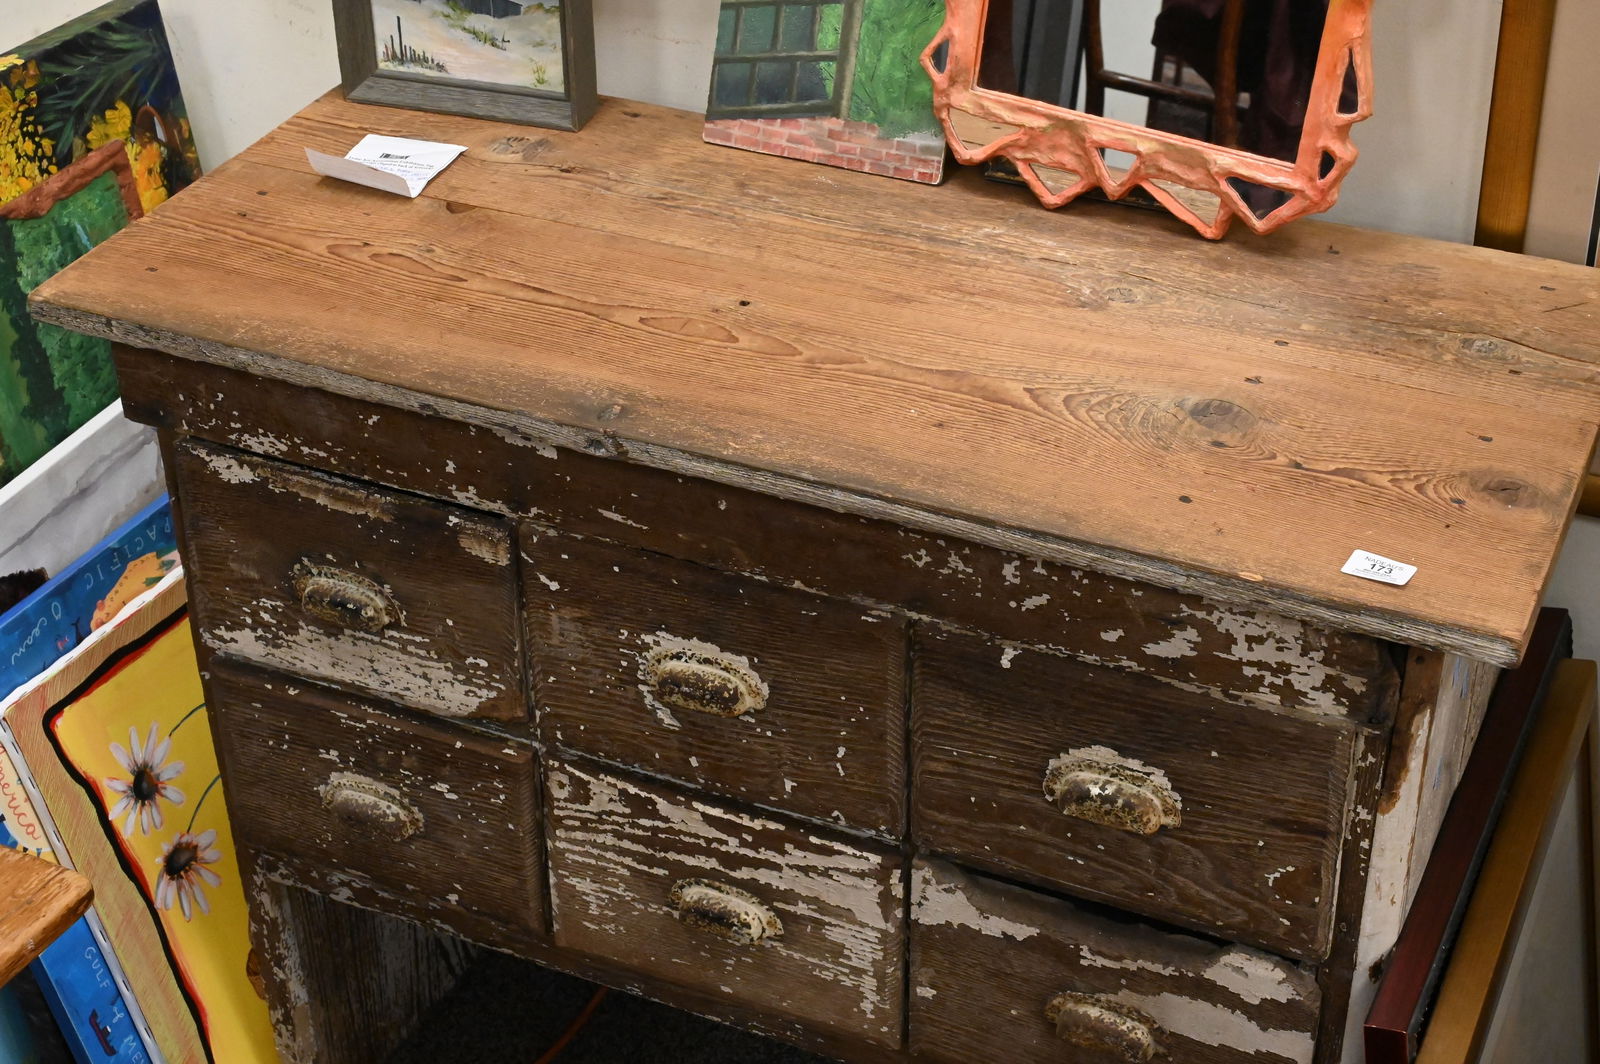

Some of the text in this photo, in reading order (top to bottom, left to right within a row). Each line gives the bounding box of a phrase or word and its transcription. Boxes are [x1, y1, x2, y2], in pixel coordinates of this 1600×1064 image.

[84, 515, 172, 591] PACIFIC
[1370, 563, 1393, 574] 173
[85, 946, 111, 988] GULF
[123, 1034, 146, 1064] ME
